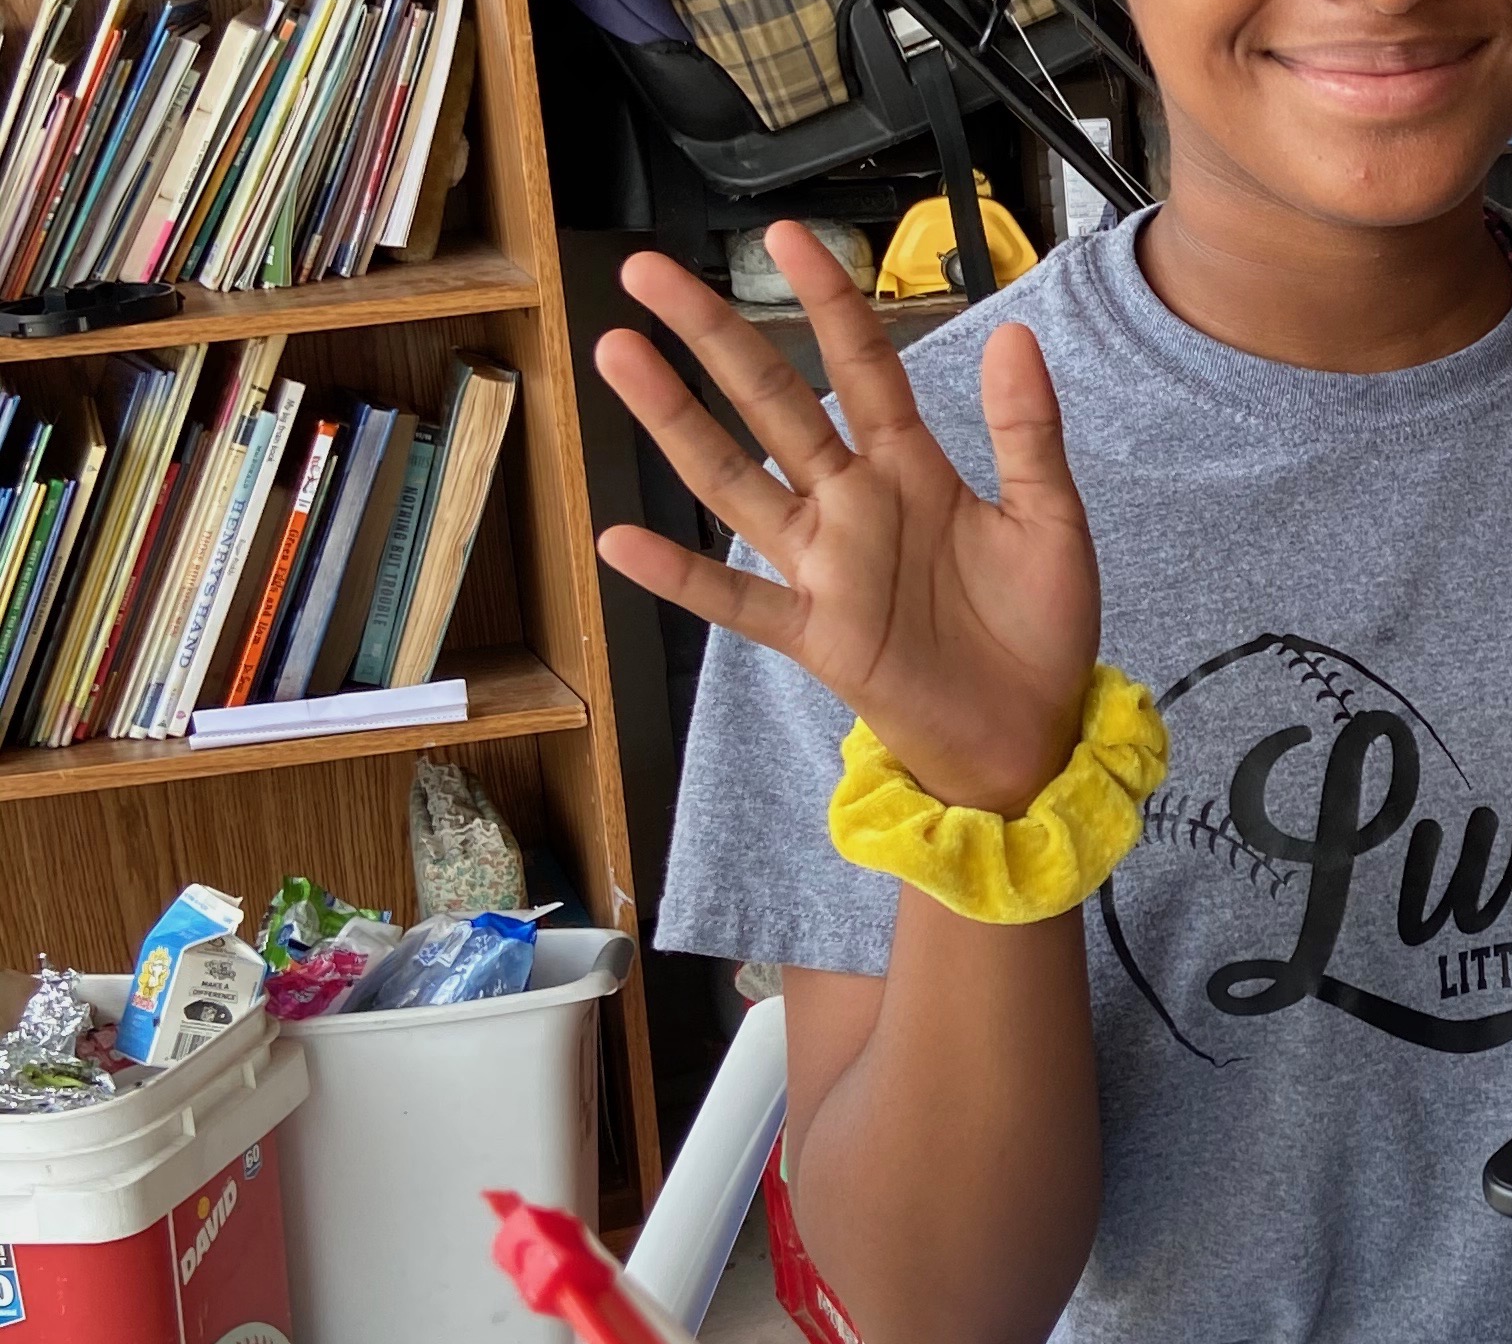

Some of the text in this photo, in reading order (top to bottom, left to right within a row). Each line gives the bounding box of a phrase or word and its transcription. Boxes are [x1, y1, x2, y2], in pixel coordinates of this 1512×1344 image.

[267, 398, 296, 463] My big train book
[391, 485, 418, 541] NOTHING
[202, 497, 246, 599] HENRY'S
[385, 543, 405, 569] BUT
[250, 526, 301, 647] Green Eggs and Ham
[372, 572, 398, 627] TROUBLE
[177, 602, 211, 670] HAND
[192, 988, 237, 1001] DIFFERENCE
[201, 980, 223, 989] MAKE
[244, 1143, 261, 1170] 60
[181, 1179, 238, 1286] DAVID
